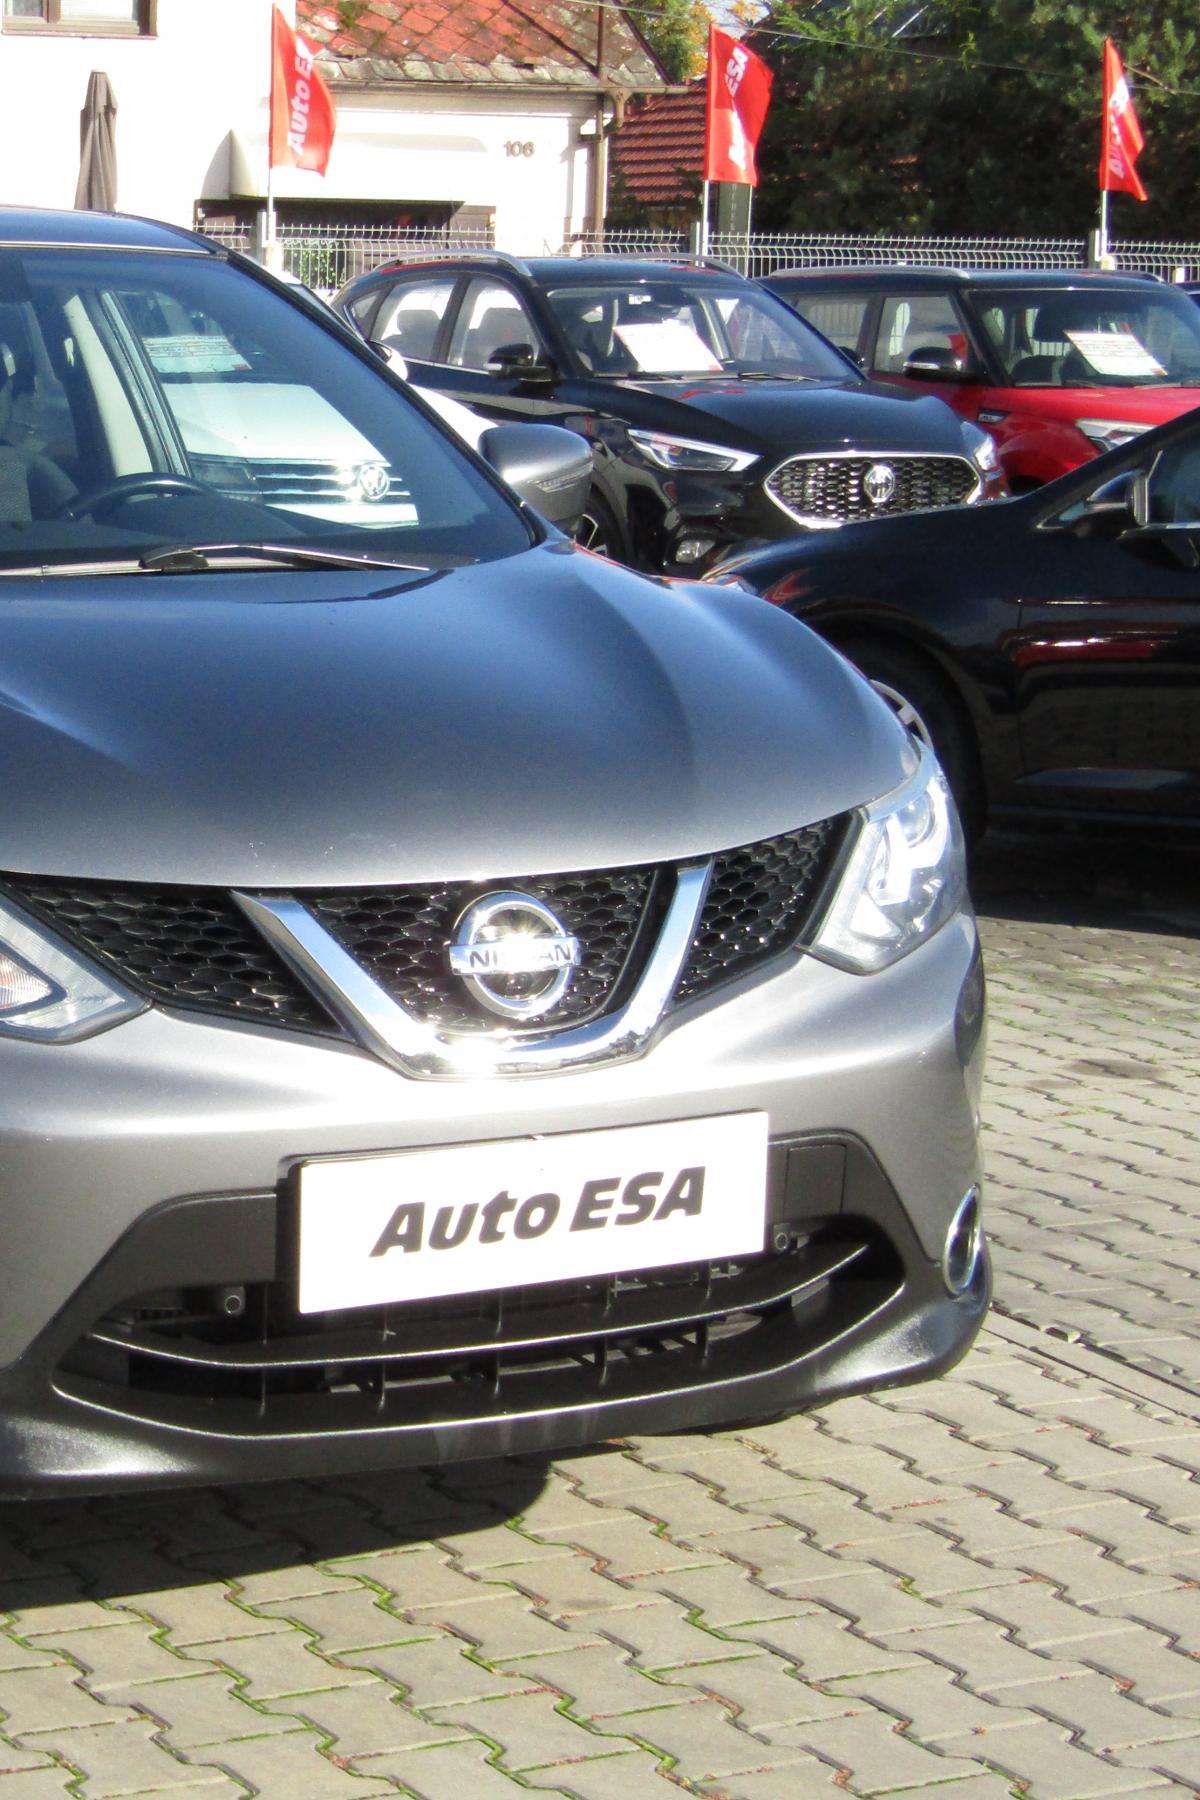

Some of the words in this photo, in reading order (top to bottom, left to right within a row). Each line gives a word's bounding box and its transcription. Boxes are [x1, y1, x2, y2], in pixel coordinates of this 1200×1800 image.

[288, 80, 311, 156] Auto
[503, 140, 535, 158] 106
[469, 944, 572, 969] NIAN
[368, 1190, 561, 1258] Auto
[569, 1166, 706, 1232] ESA
